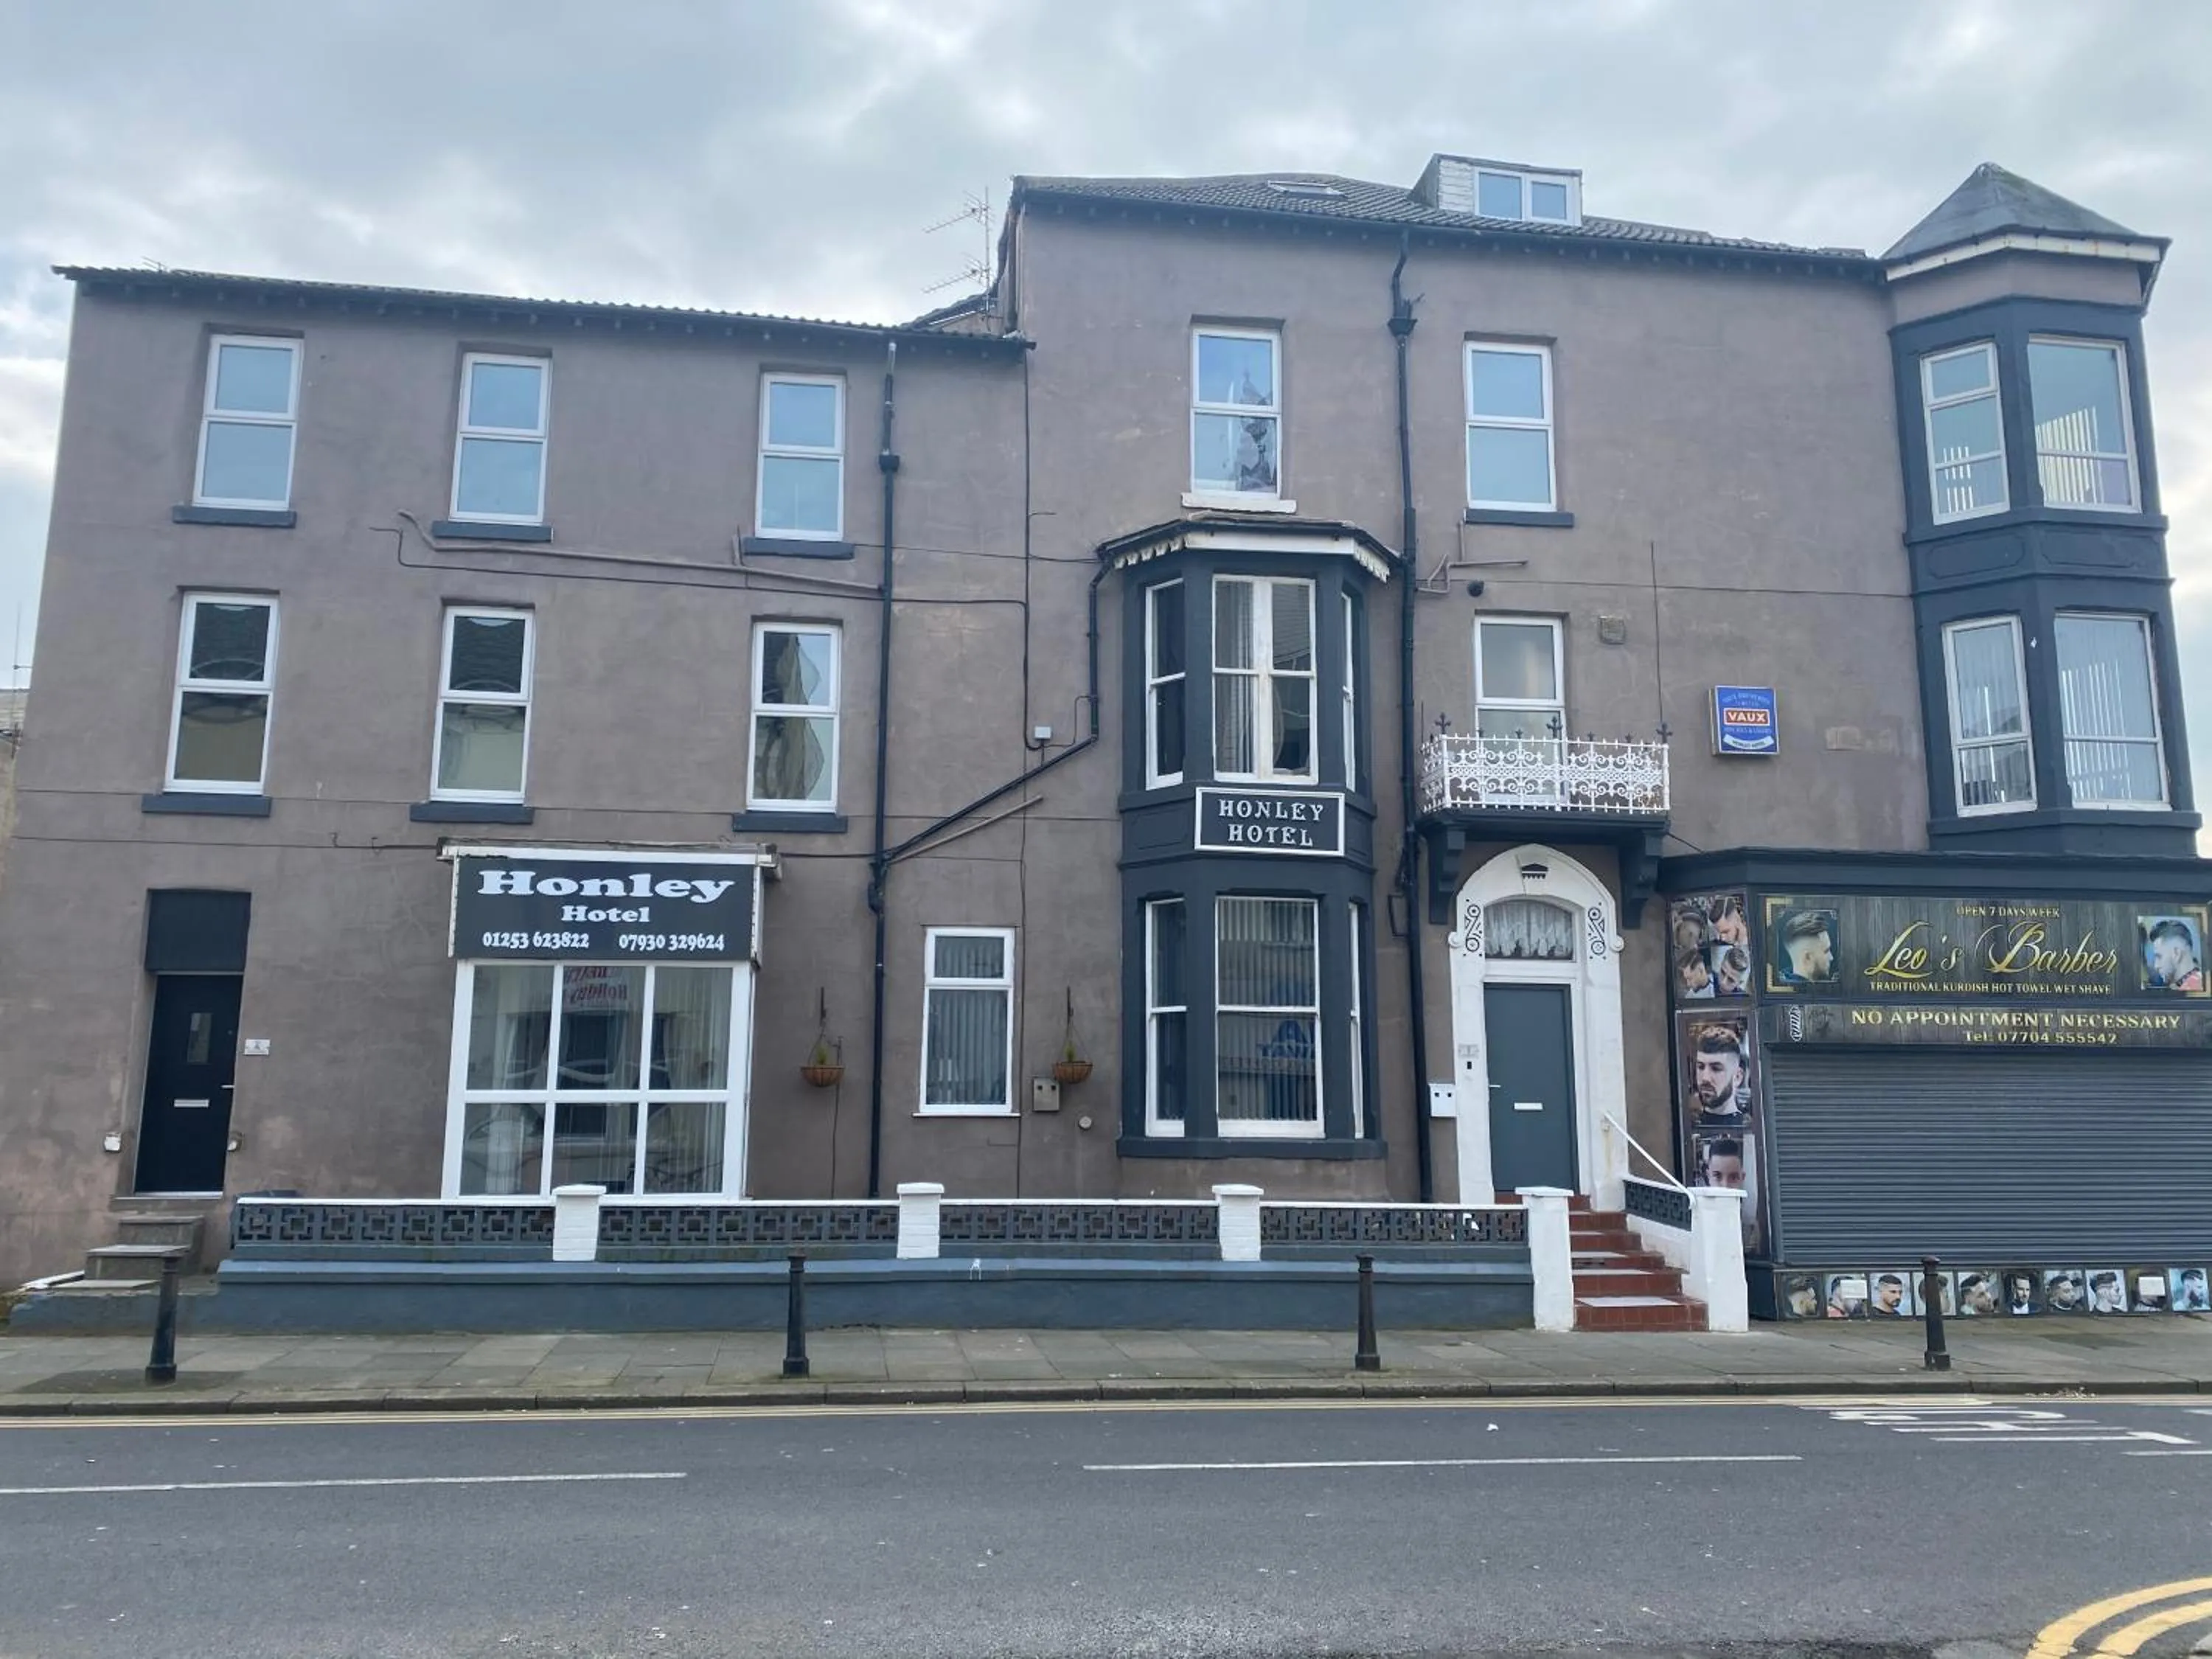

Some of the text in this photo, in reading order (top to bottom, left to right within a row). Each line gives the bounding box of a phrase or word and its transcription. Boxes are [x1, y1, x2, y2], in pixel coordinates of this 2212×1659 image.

[1728, 712, 1766, 722] VAUX
[1218, 799, 1324, 821] HONLEY
[1228, 824, 1313, 847] HOTEL
[478, 870, 734, 903] Honley
[561, 905, 650, 922] Hotel
[1956, 906, 1986, 917] OPEN
[1989, 907, 1995, 916] 7
[483, 932, 724, 951] 01253 623822 07930 329624
[1975, 921, 2118, 974] Barber
[1870, 981, 2111, 995] TRADITIONAL KURDISH HOT TOWEL WET SHAVE
[1852, 1010, 2181, 1029] NO APPOINTMENT NECESSARY
[1998, 1032, 2050, 1043] 07704
